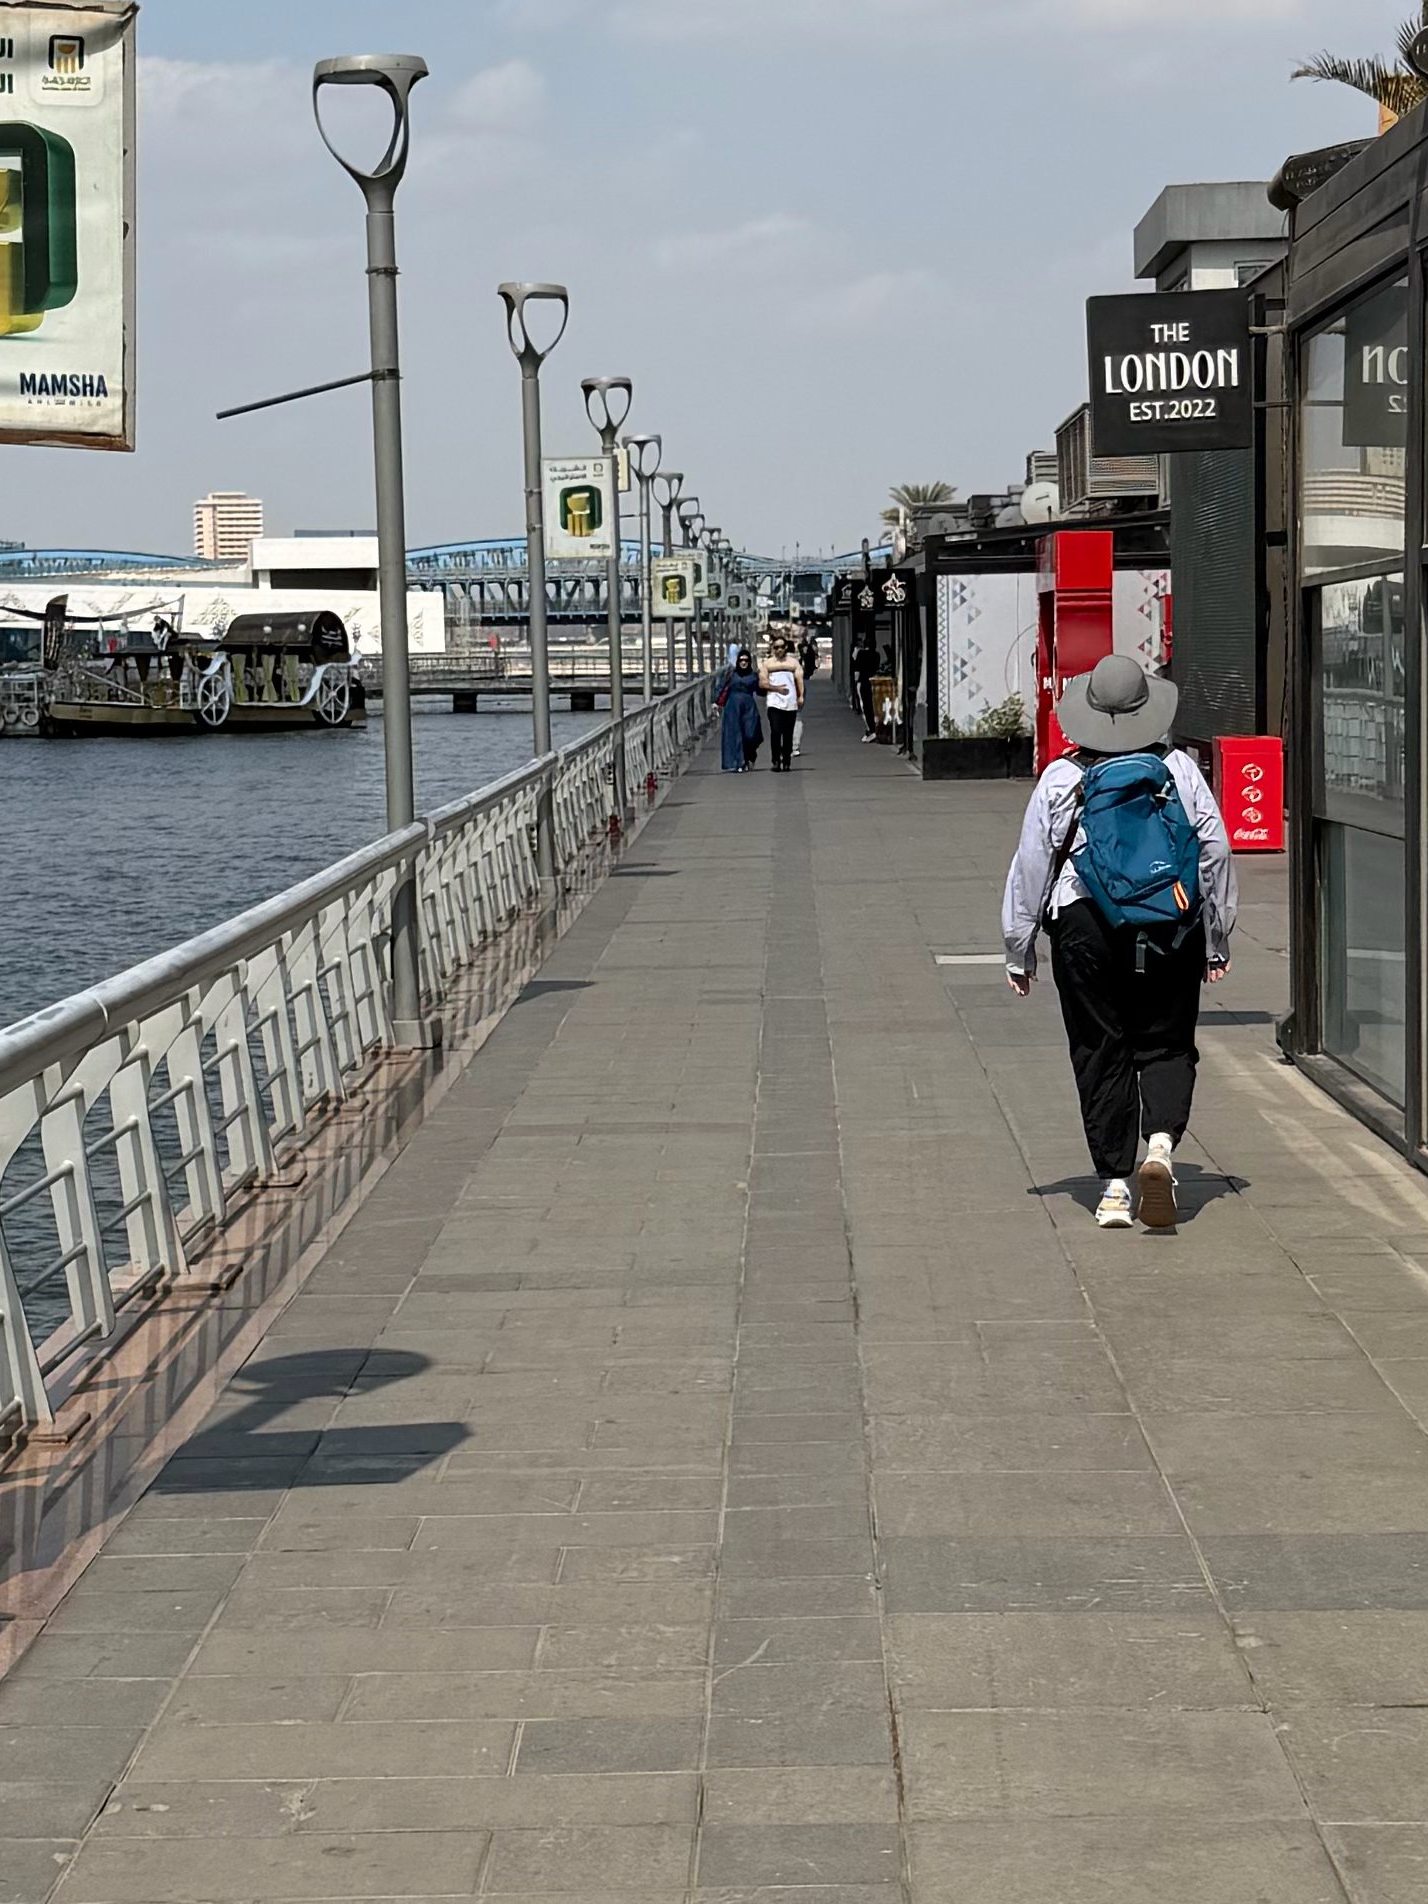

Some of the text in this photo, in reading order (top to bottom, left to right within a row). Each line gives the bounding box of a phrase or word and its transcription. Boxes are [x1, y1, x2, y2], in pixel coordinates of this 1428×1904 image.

[1150, 322, 1191, 344] THE
[1104, 348, 1240, 395] LONDON
[19, 372, 109, 398] MAMSHA
[1129, 399, 1217, 422] EST.2022
